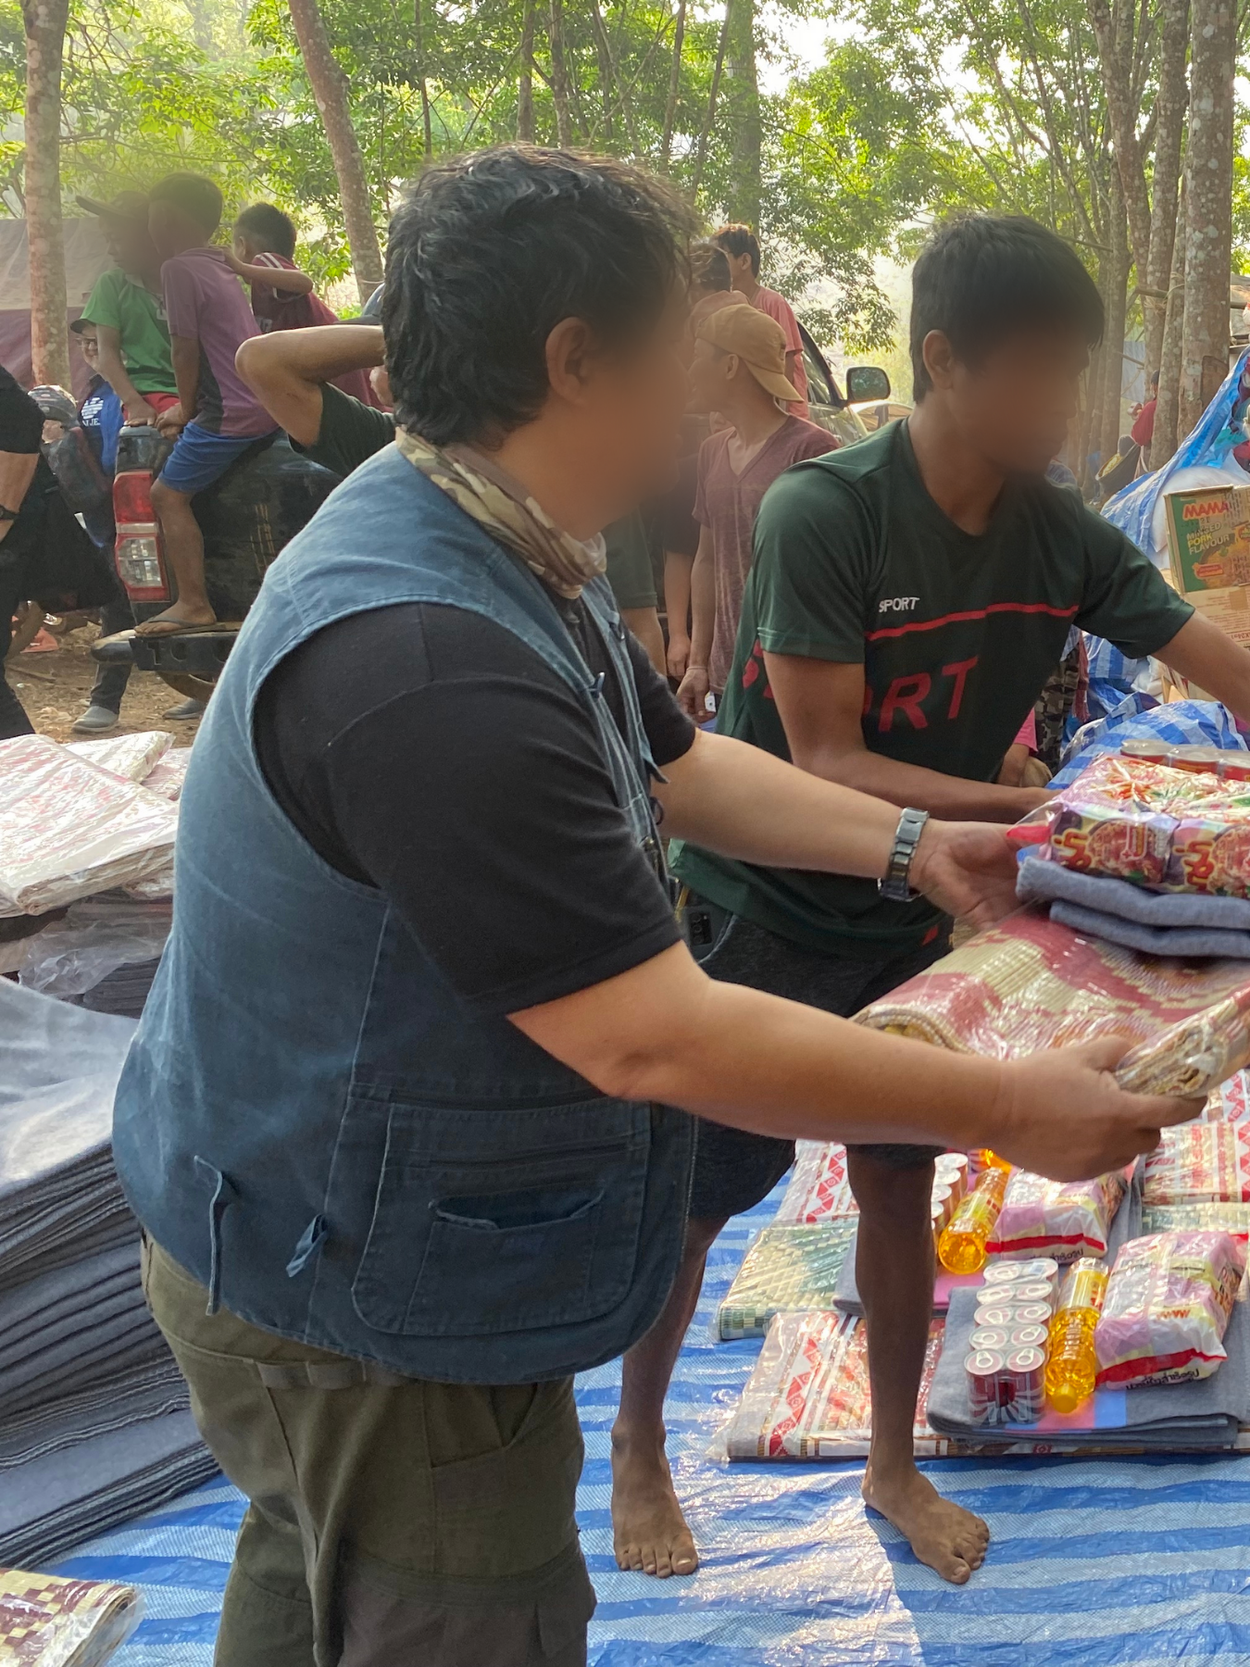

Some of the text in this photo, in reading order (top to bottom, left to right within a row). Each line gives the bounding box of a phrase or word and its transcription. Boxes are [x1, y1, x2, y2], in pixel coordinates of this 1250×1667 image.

[1183, 501, 1229, 519] MAMA
[1188, 533, 1213, 548] PORK
[1189, 535, 1230, 555] FLAVOUR
[878, 596, 920, 613] SPORT
